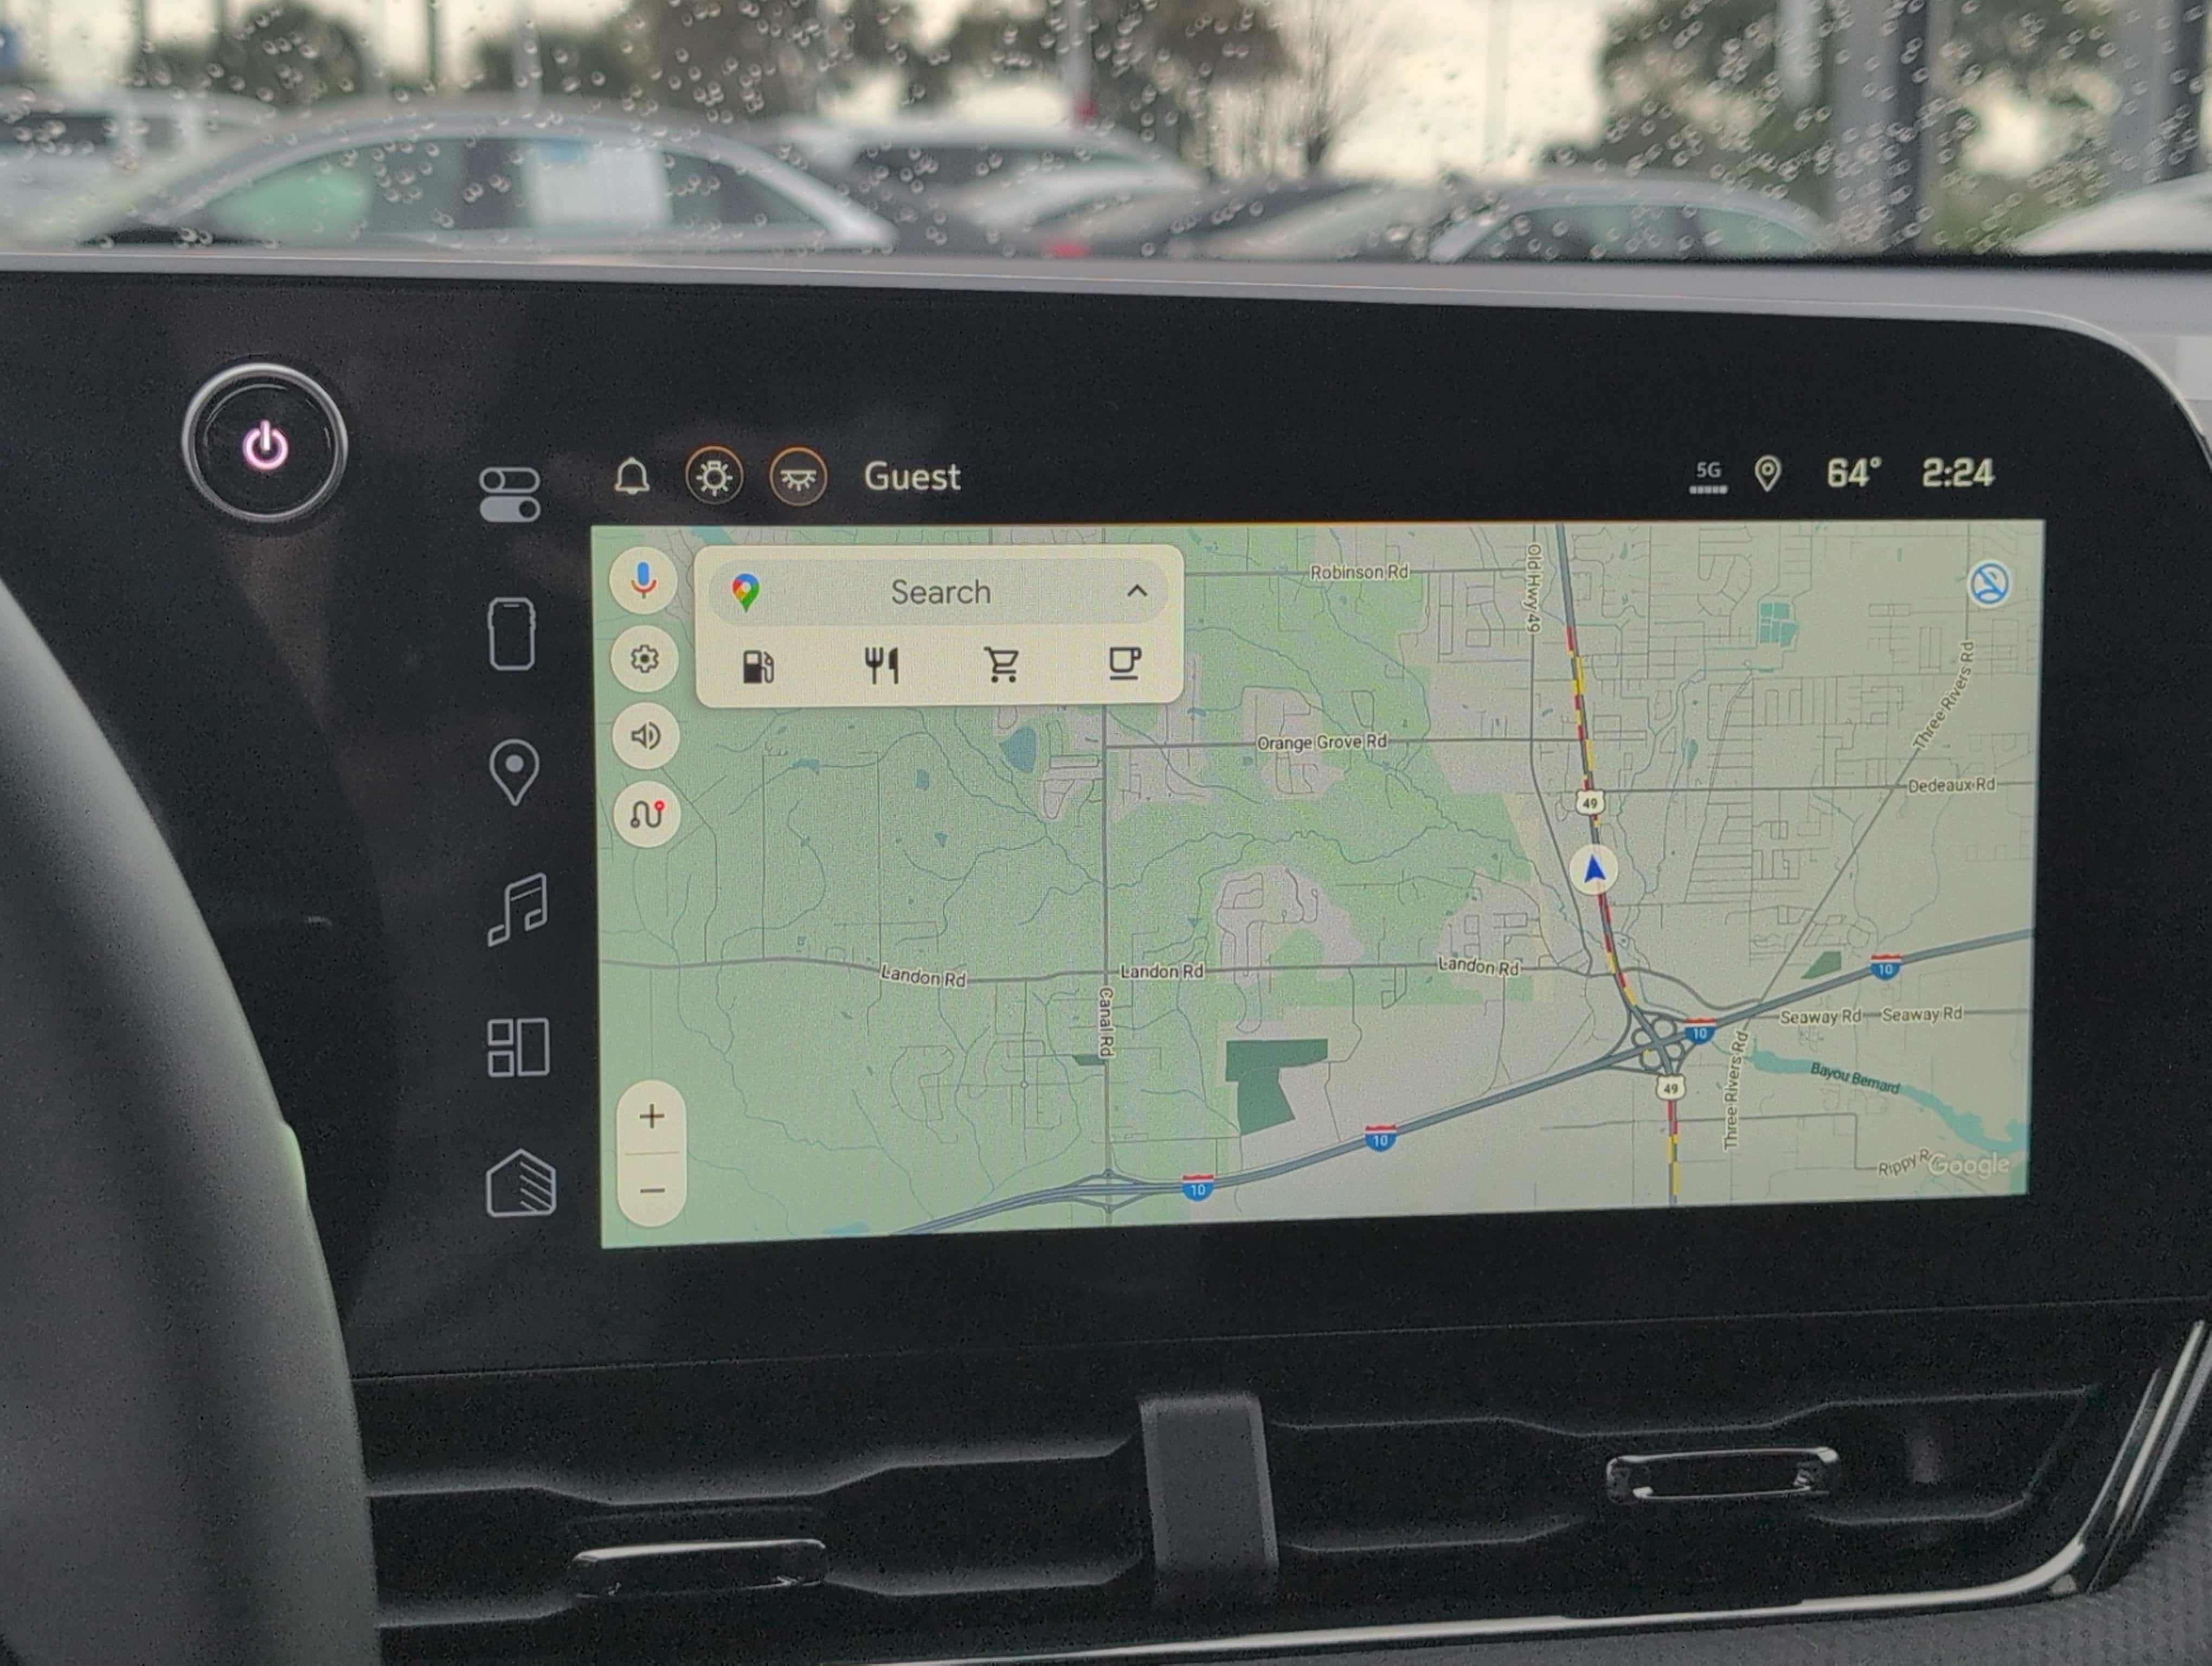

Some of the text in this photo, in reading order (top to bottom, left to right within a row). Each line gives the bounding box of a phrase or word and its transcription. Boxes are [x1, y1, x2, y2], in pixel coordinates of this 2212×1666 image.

[865, 460, 962, 491] Guest
[1696, 462, 1722, 479] 5G
[1827, 456, 1882, 488] 64°
[1922, 457, 1996, 488] 2:24
[1311, 564, 1409, 580] Robinson Rd
[891, 578, 991, 605] Search
[1523, 544, 1542, 633] Old Hwy 49
[1913, 642, 1975, 749] Three Rivers Rd
[1258, 734, 1387, 753] Orange Grove Rd
[1909, 777, 1996, 793] Dedeaux Rd
[1583, 798, 1598, 809] 49
[1121, 964, 1204, 979] Landon Rd
[1439, 956, 1519, 976] Landon Rd
[1877, 964, 1893, 975] 10
[882, 965, 966, 988] Landon Rd
[1099, 987, 1114, 1057] Canal Rd
[1780, 1008, 1862, 1026] Seaway Rd
[1882, 1005, 1963, 1024] Seaway Rd
[1693, 1028, 1707, 1039] 10
[1811, 1061, 1900, 1094] Bayou Bernard
[1663, 1083, 1679, 1094] 49
[1724, 1031, 1748, 1150] Three Rivers Rd
[1372, 1135, 1387, 1146] 10
[1878, 1154, 1917, 1177] Rippy
[1928, 1151, 2010, 1180] Google
[1190, 1184, 1205, 1196] 10
